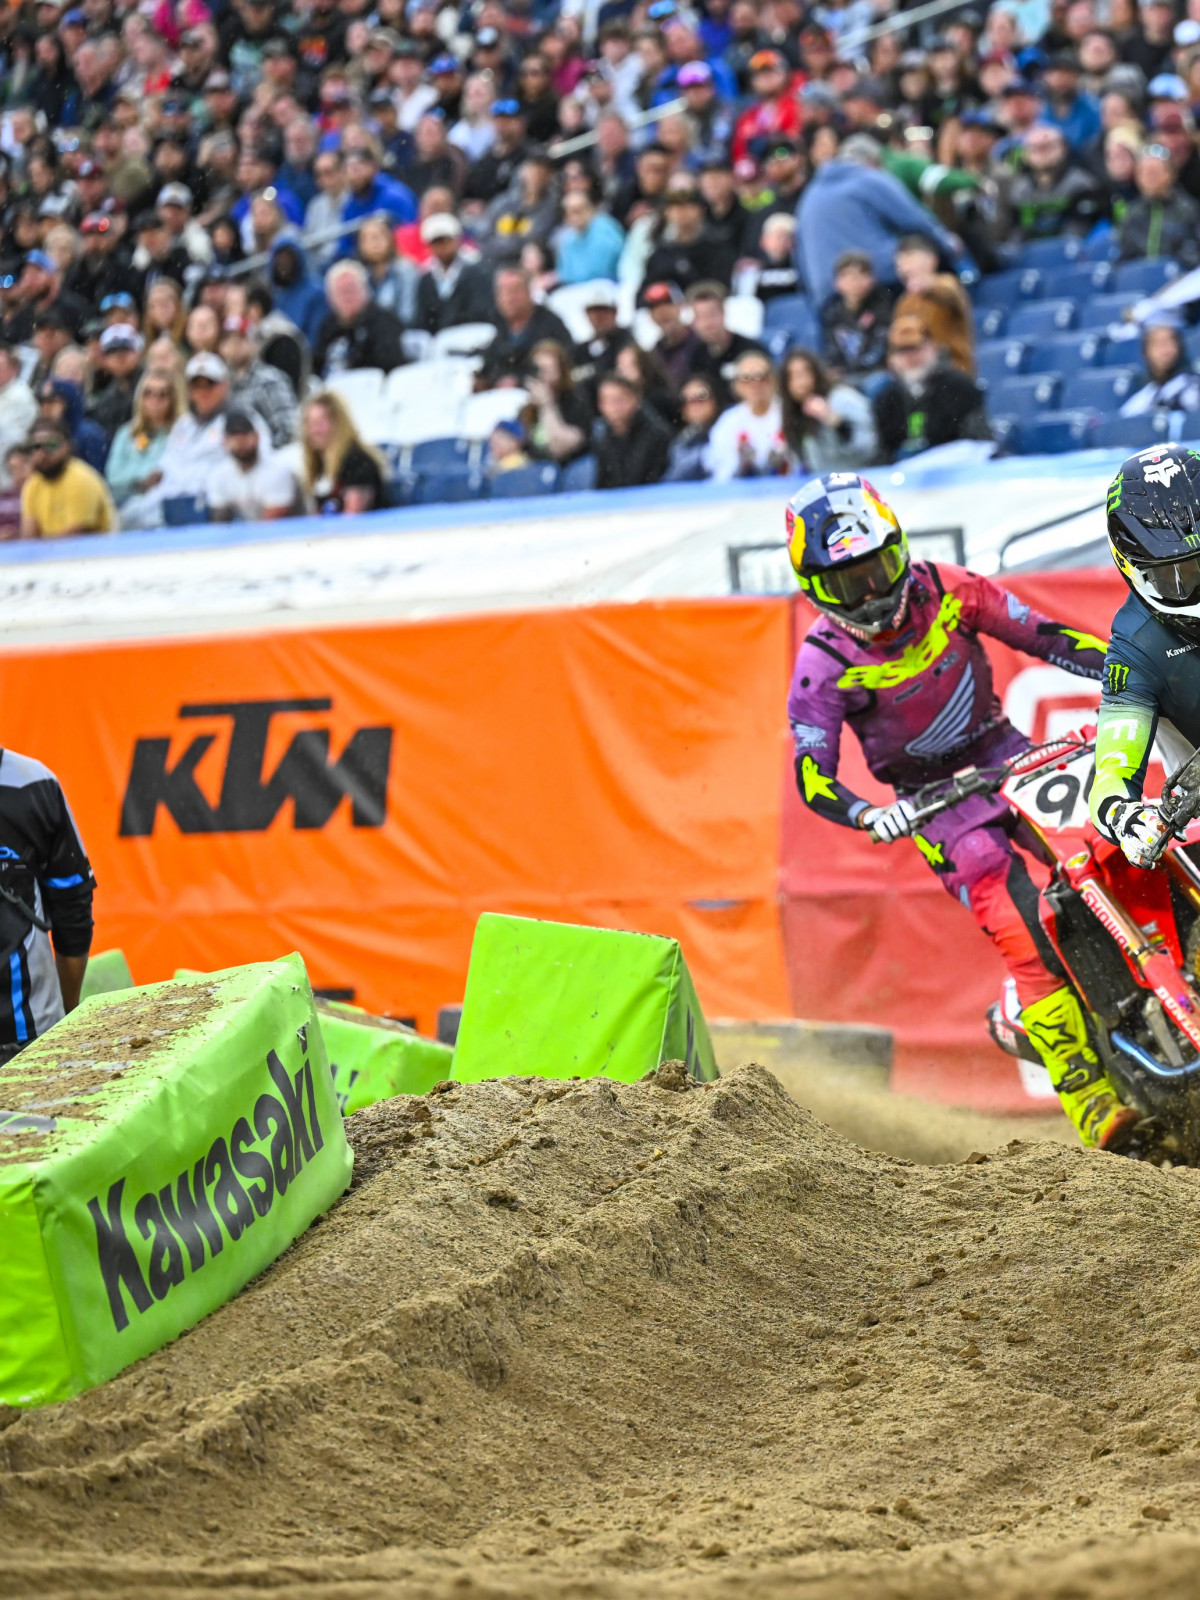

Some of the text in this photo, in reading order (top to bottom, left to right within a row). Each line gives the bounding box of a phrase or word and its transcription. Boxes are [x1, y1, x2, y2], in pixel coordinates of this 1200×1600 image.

[1048, 653, 1102, 679] HOND
[1166, 643, 1198, 658] Kawas
[118, 696, 394, 838] KTM
[86, 1021, 325, 1333] Kawasaki
